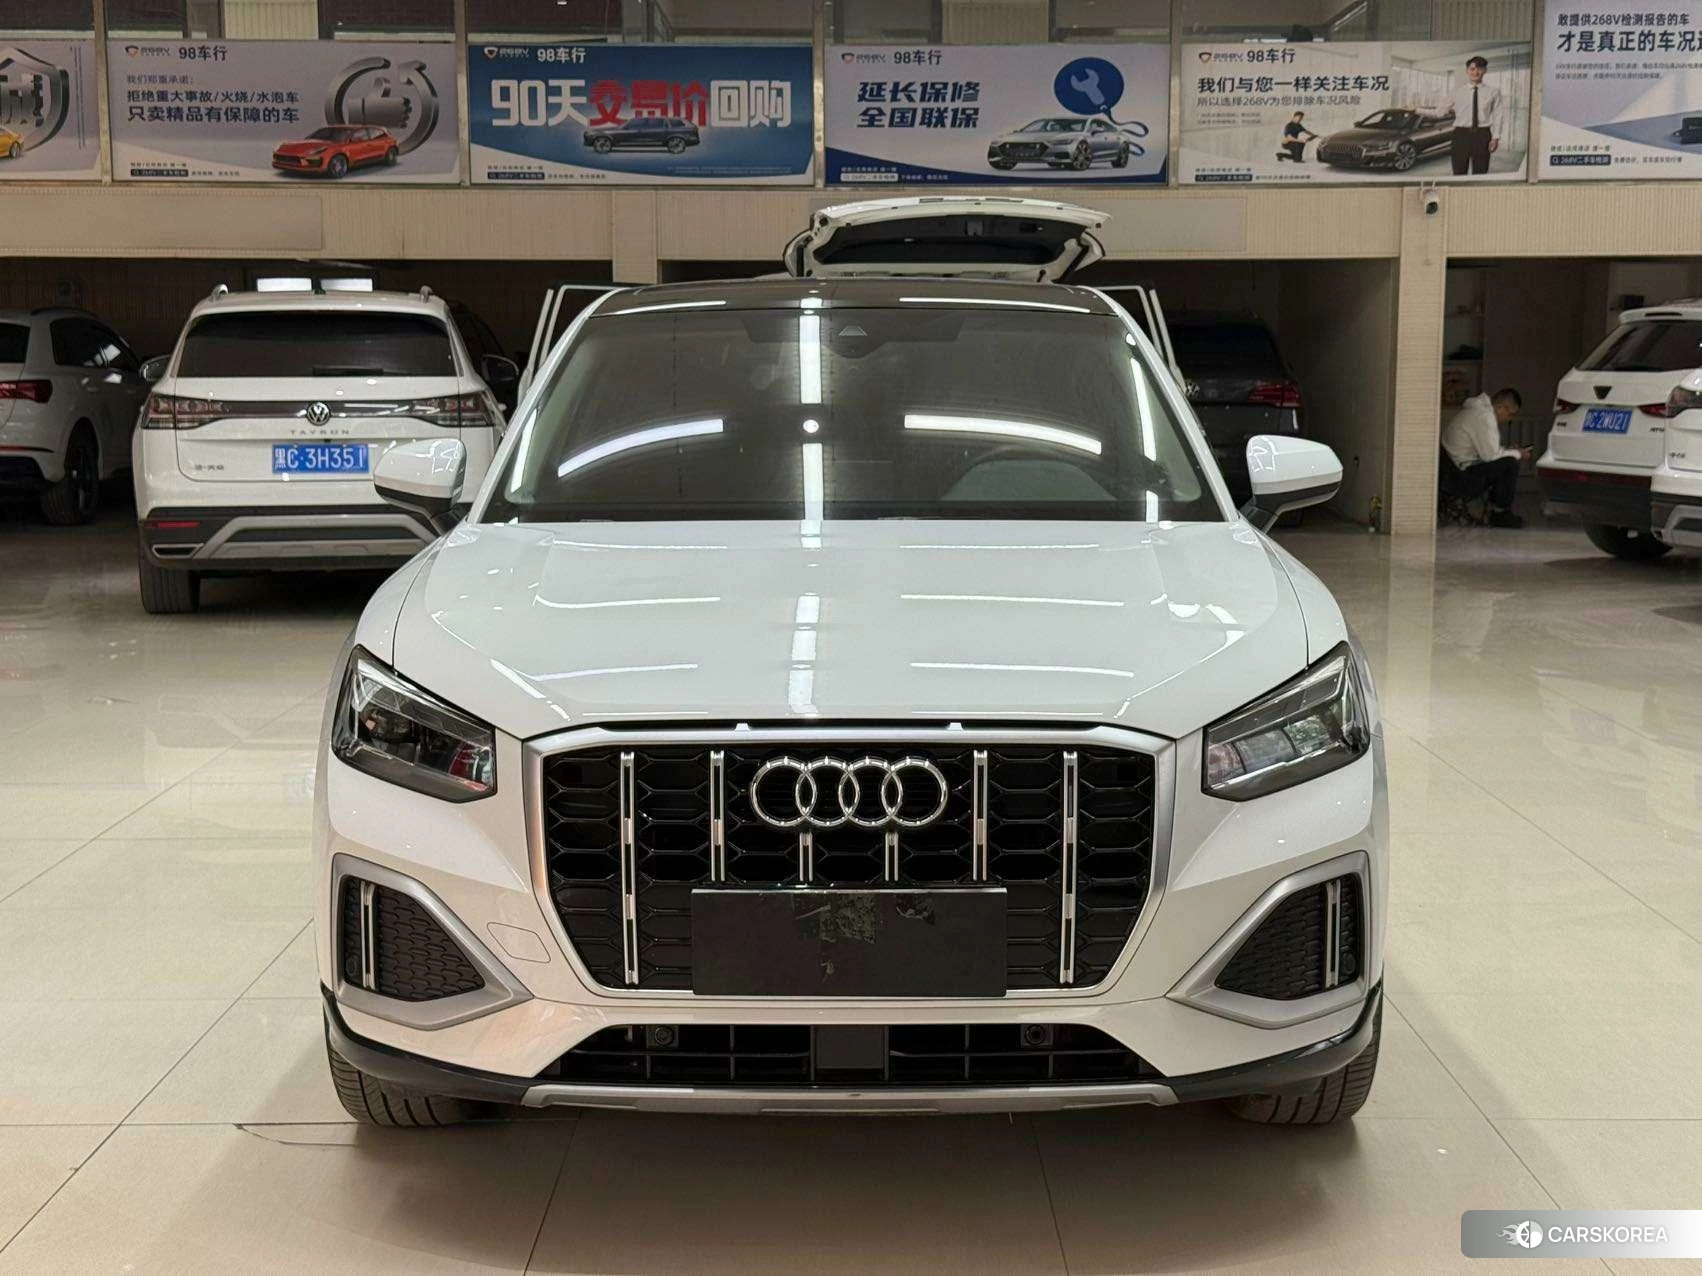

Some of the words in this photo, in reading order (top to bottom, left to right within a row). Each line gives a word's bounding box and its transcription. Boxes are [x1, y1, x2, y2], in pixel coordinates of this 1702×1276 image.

[1556, 31, 1702, 52] 才是真正的车况
[179, 45, 228, 63] 98车行
[537, 47, 586, 64] 98车行
[894, 49, 943, 66] 98车行
[1247, 48, 1296, 63] 98车行
[857, 81, 981, 103] 延长保修
[1197, 75, 1391, 93] 我们与您一样关注车况
[126, 90, 300, 103] 拒绝重大事故/火烧/水泡车
[491, 79, 792, 128] 90天交易价回购
[127, 105, 300, 124] 只卖精品有保障的车
[857, 107, 981, 129] 全国联保
